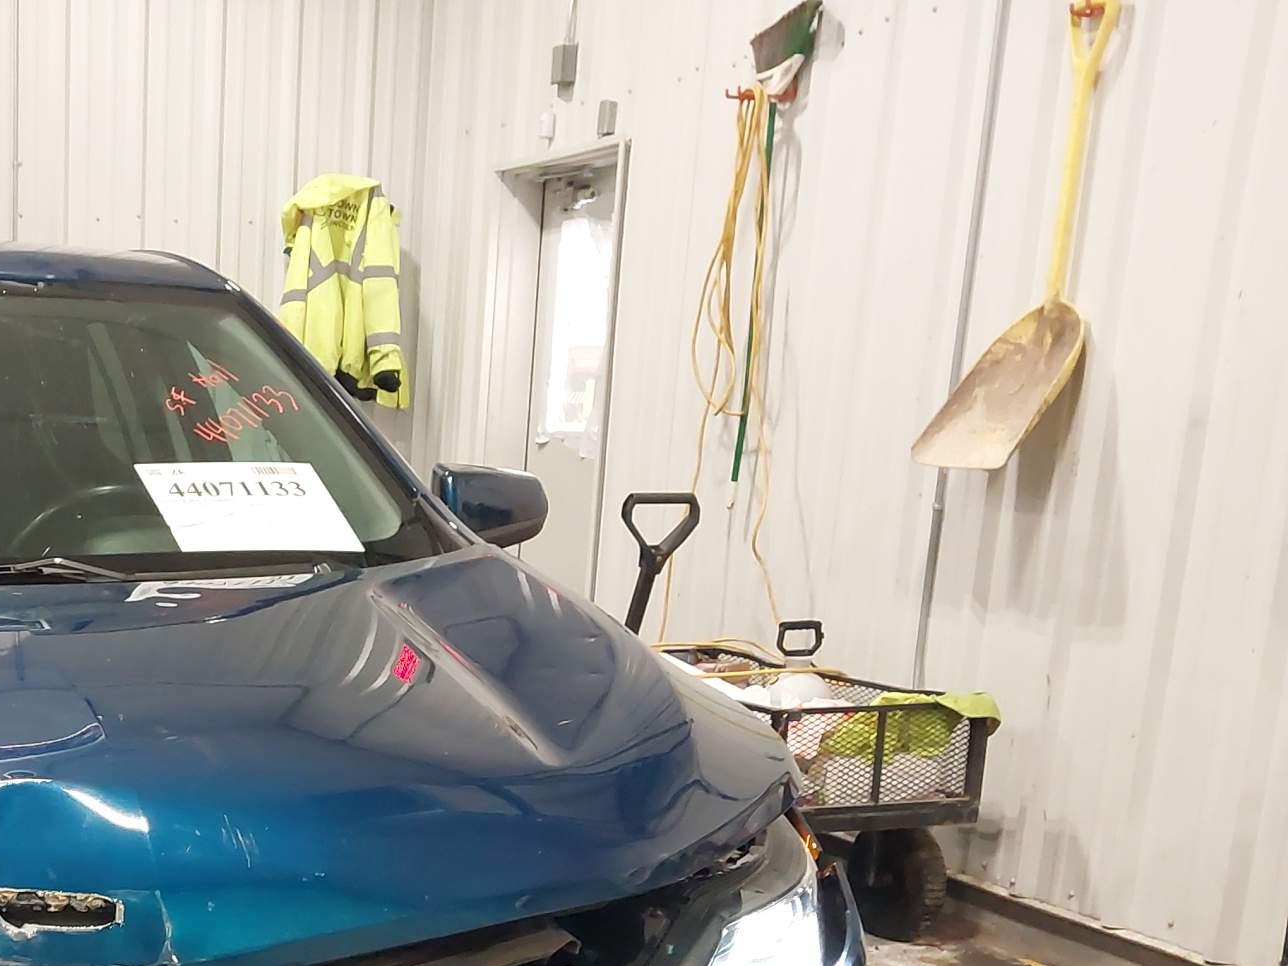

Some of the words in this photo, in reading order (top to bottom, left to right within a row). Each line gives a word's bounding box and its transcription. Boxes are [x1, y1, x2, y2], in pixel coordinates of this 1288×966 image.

[328, 199, 360, 214] OWN
[328, 208, 357, 223] TOWN
[193, 385, 299, 442] 44071133
[169, 481, 306, 497] 44071133
